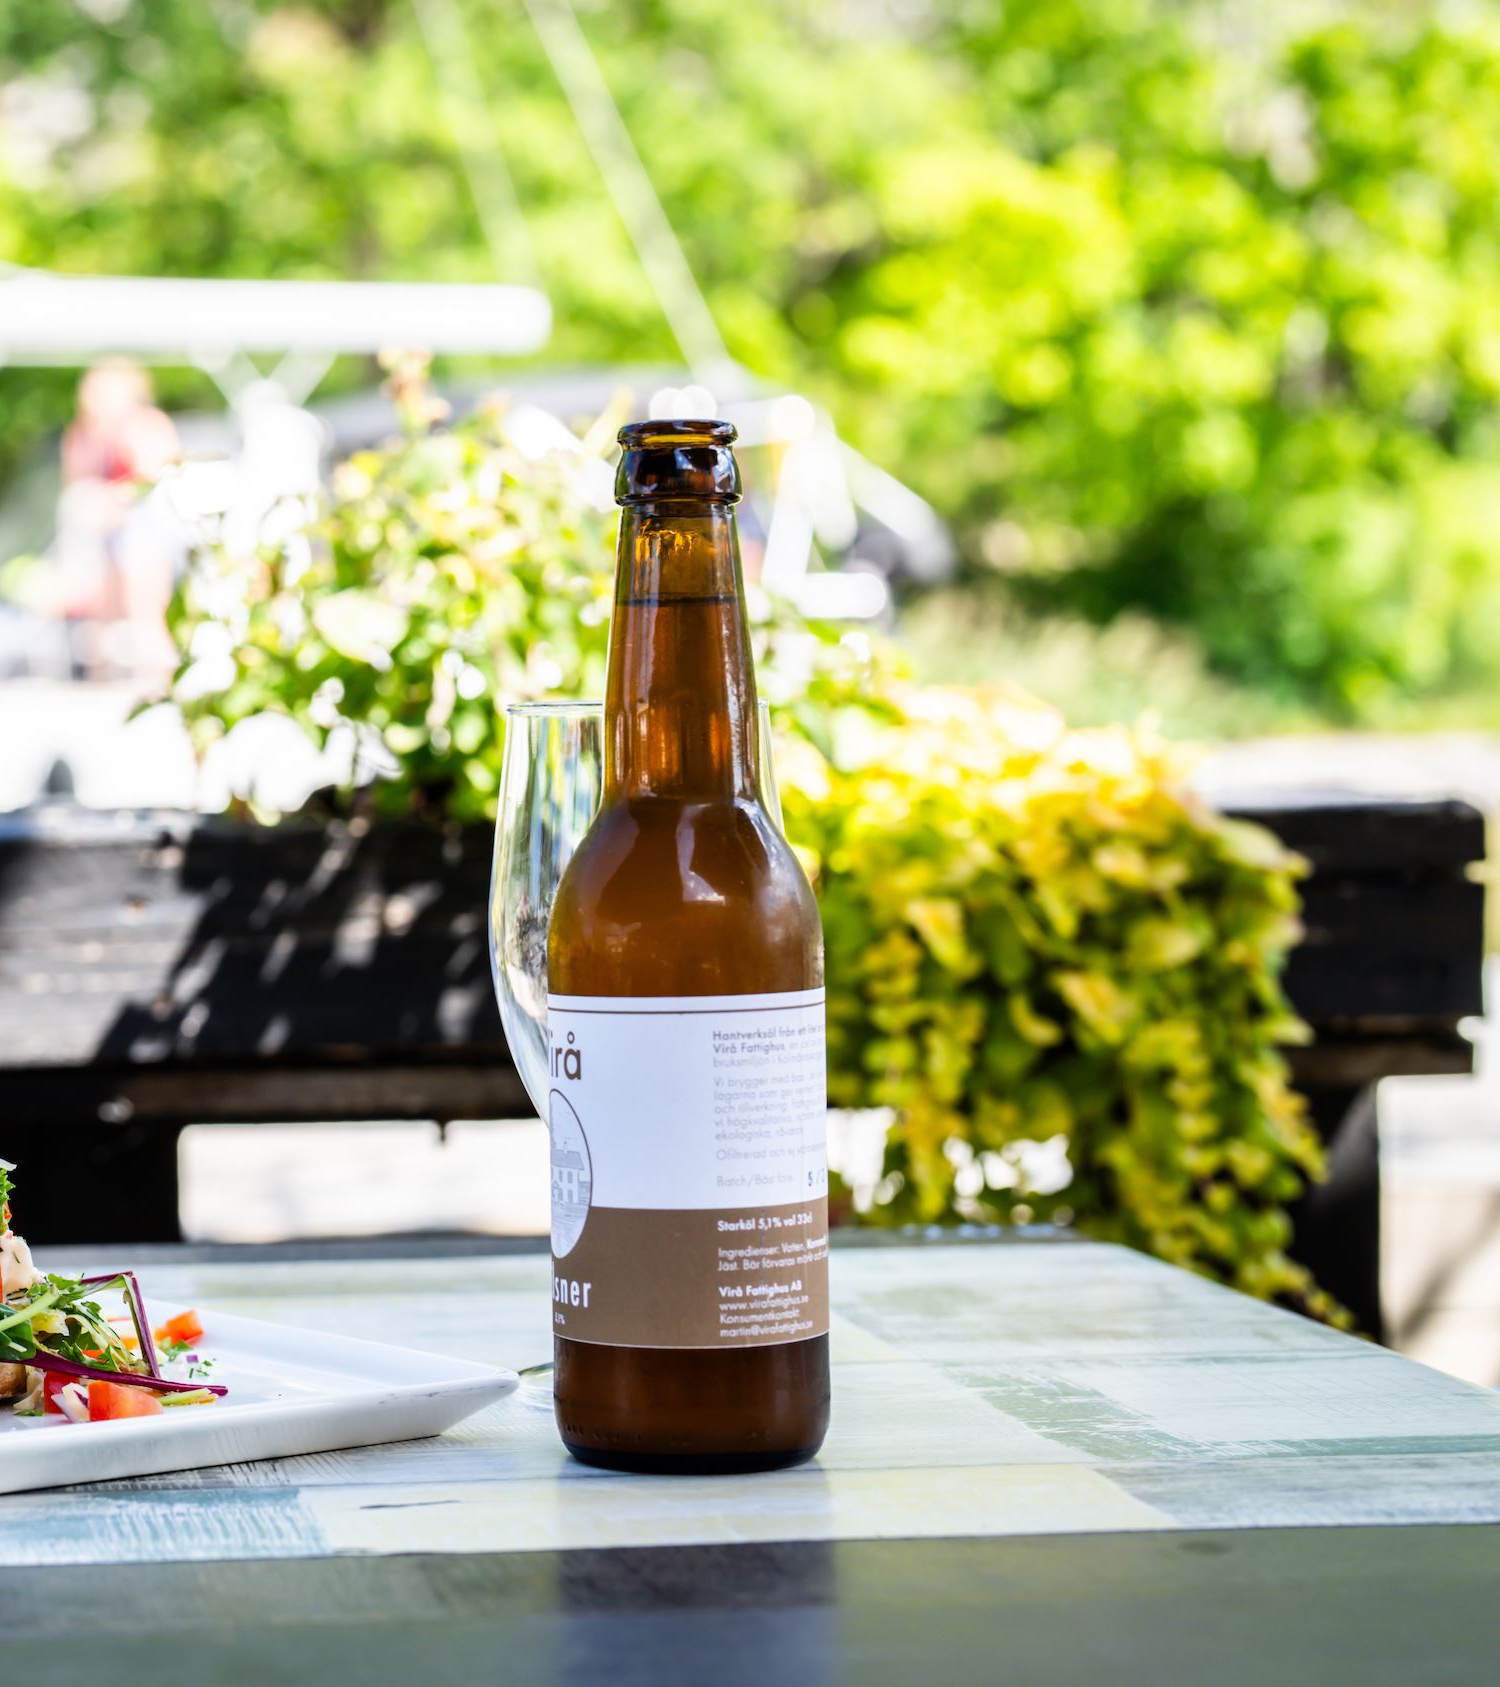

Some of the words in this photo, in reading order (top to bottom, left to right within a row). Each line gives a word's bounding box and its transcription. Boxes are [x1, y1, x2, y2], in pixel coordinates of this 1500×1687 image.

[713, 1028, 776, 1041] Hantverksöl
[713, 1044, 738, 1054] Virå
[551, 1031, 582, 1081] irå
[713, 1078, 725, 1088] Vi
[728, 1078, 768, 1089] brygger
[714, 1104, 735, 1115] och
[716, 1149, 767, 1161] Ofiltrerad
[718, 1218, 755, 1232] Starköl
[758, 1217, 782, 1231] 5,1%
[783, 1215, 796, 1227] vol
[797, 1212, 813, 1224] 33cl
[717, 1261, 739, 1272] Jäst.
[743, 1258, 760, 1270] Bör
[763, 1257, 795, 1269] förvaras
[719, 1287, 743, 1298] Virå
[747, 1284, 789, 1298] Fattighus
[790, 1281, 803, 1291] AB
